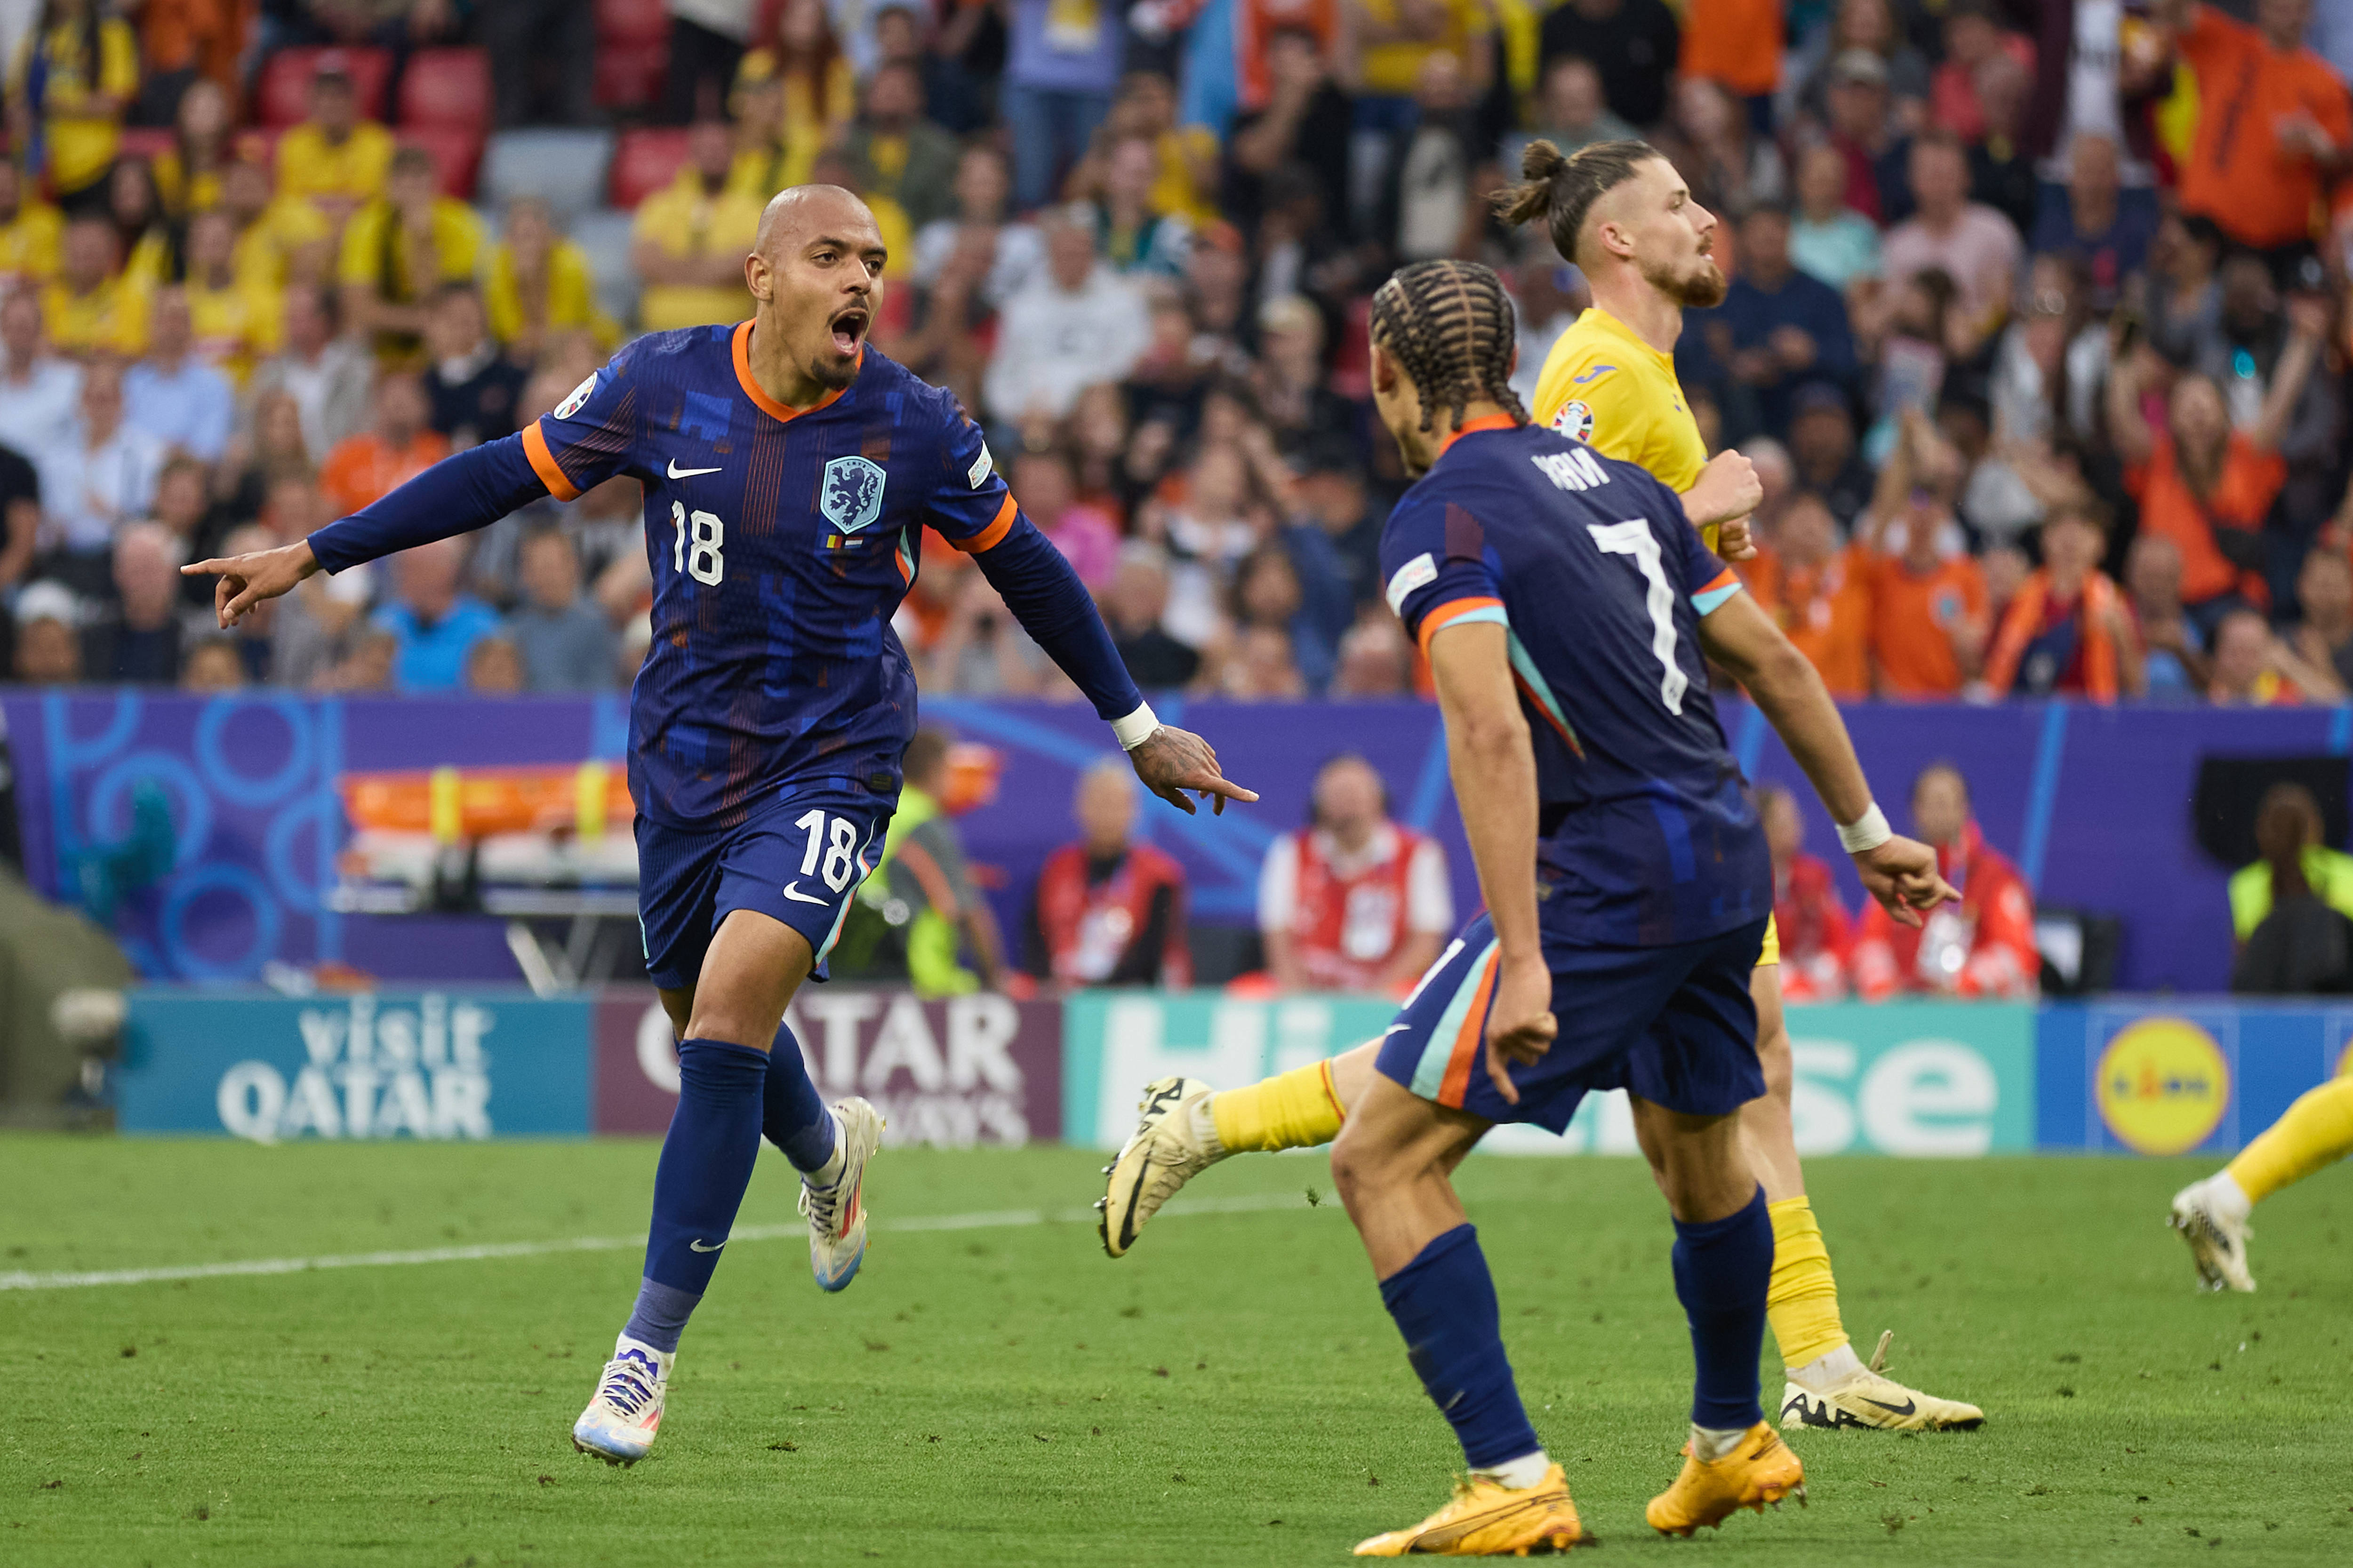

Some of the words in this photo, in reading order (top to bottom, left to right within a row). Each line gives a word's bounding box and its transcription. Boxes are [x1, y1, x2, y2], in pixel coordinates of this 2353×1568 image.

[671, 499, 724, 586] 18
[1585, 518, 1689, 716] 7
[794, 809, 856, 894] 18
[299, 993, 496, 1066] visit
[217, 1060, 492, 1146] QATAR
[1099, 994, 1998, 1156] Hise
